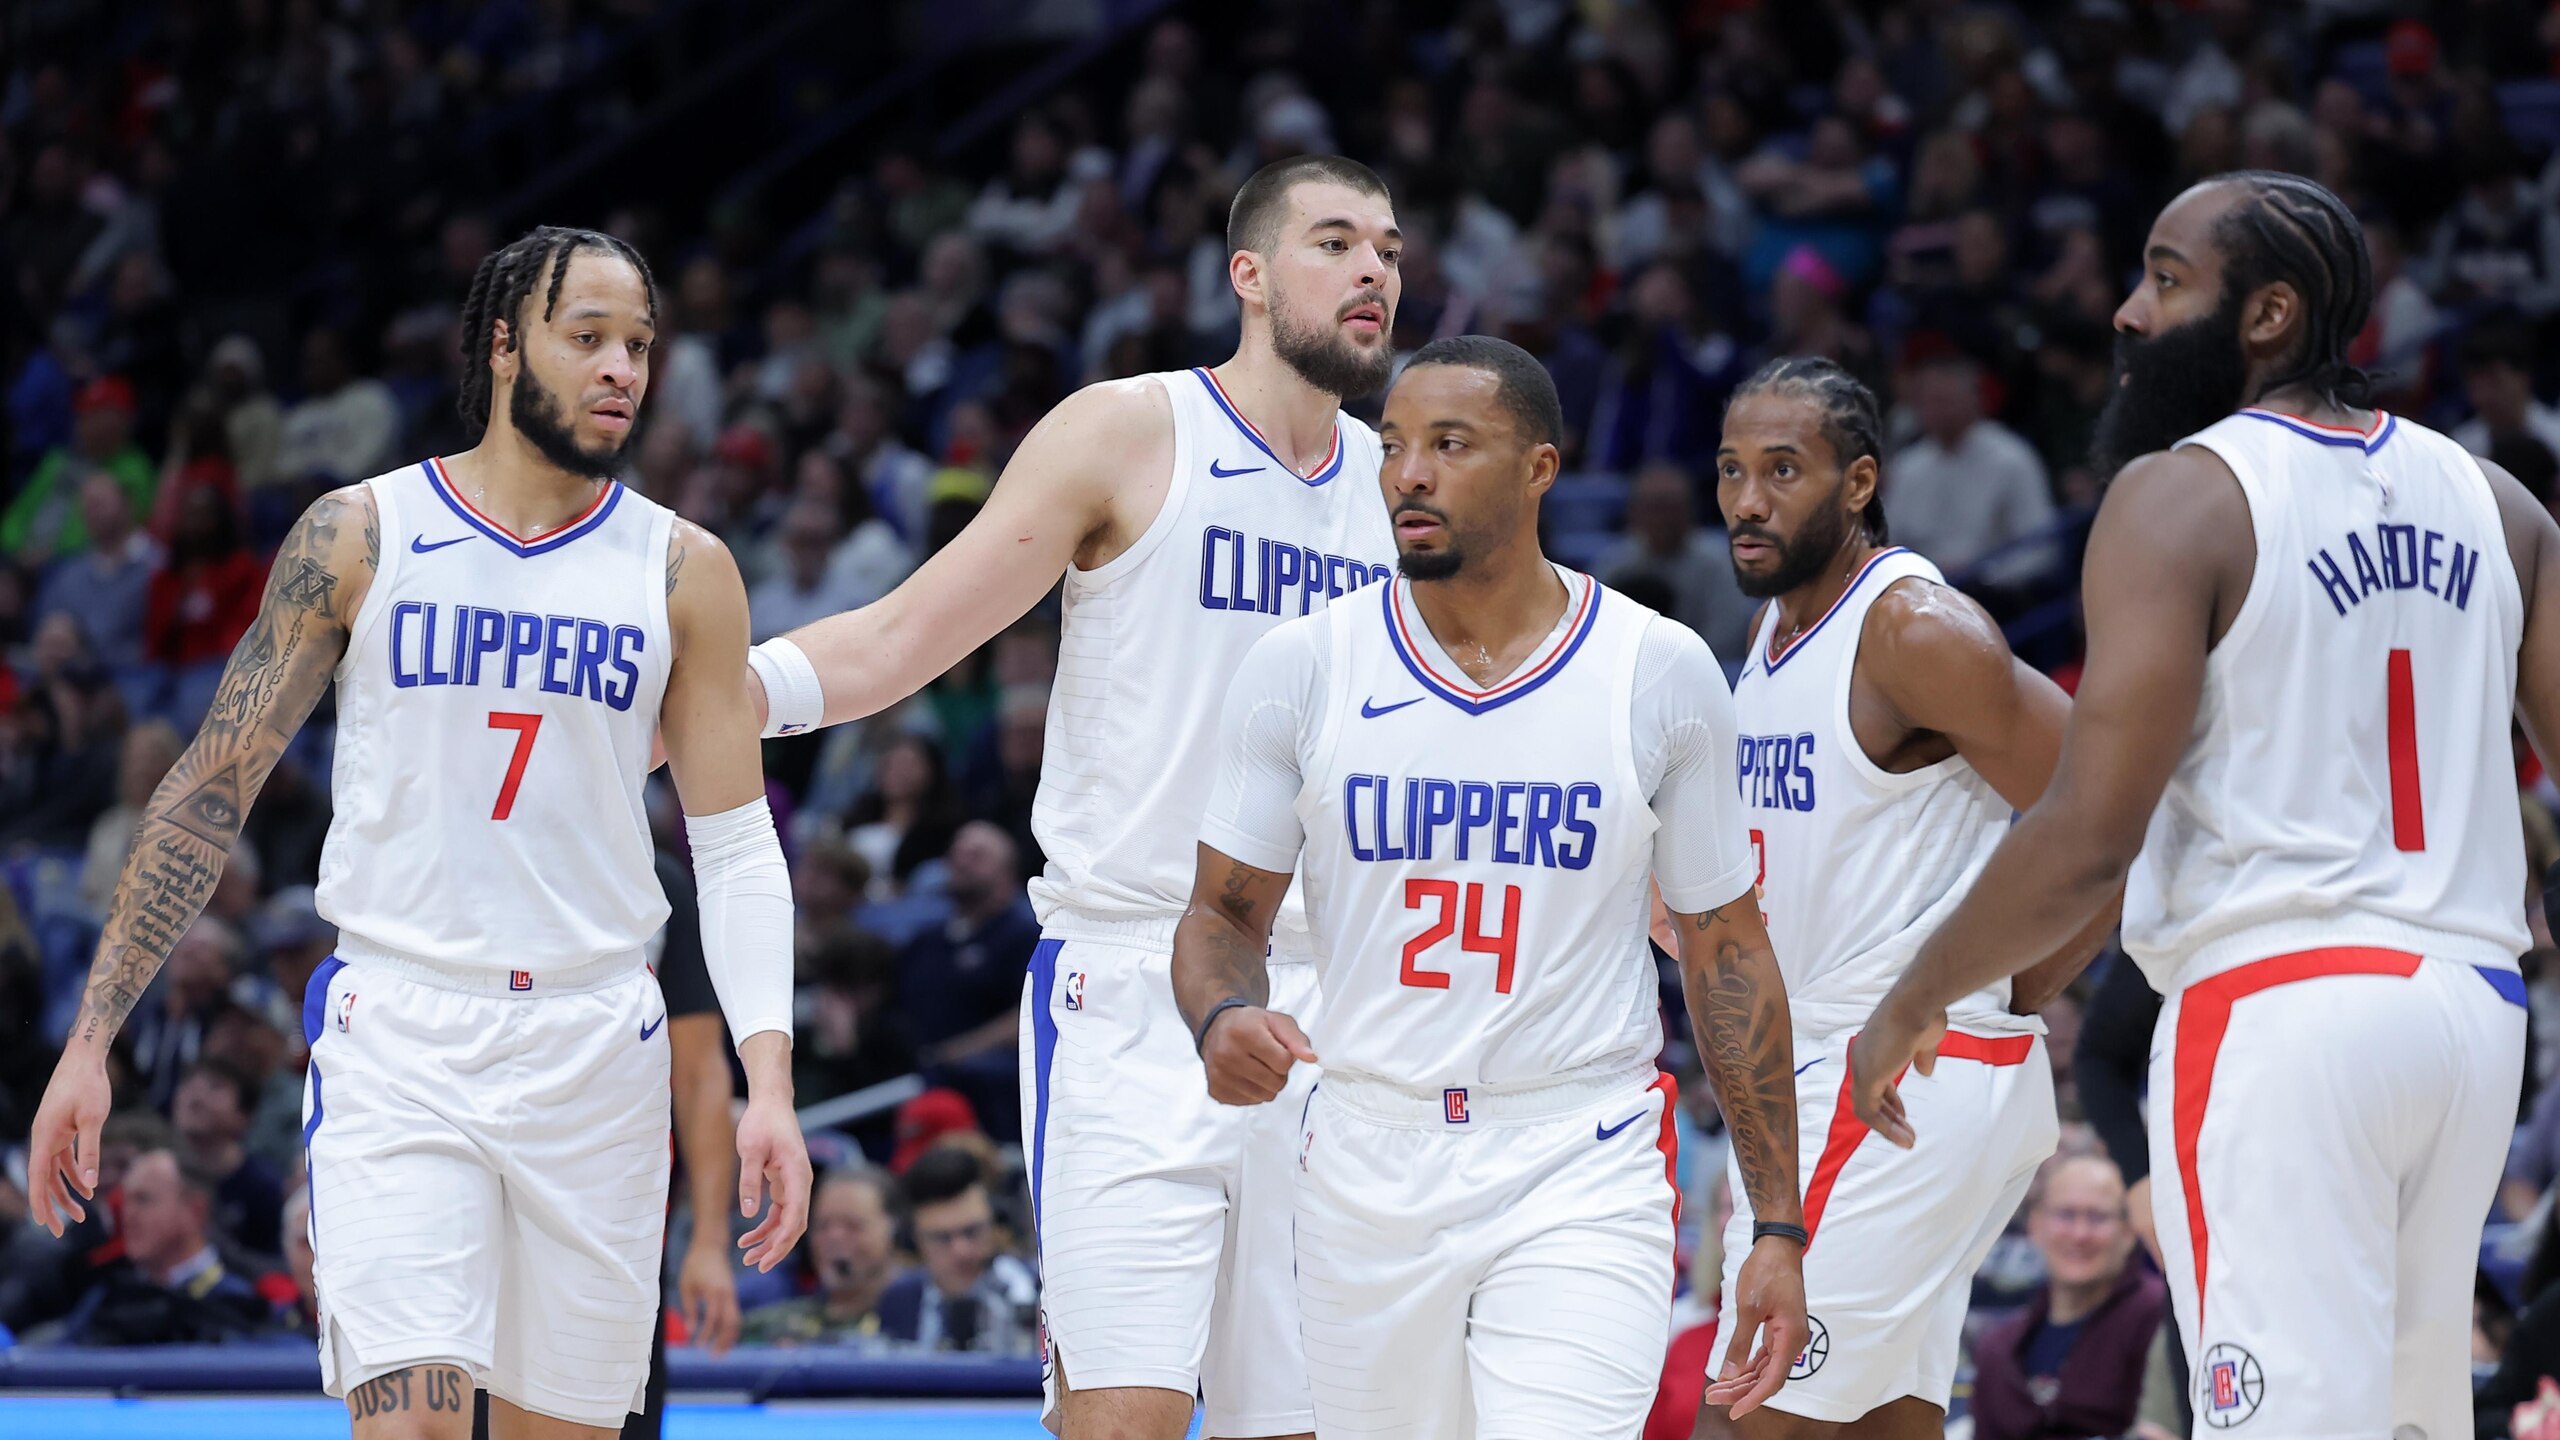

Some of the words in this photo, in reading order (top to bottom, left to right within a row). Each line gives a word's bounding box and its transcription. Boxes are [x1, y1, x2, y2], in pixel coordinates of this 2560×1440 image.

[389, 600, 645, 712] CLIPPERS
[487, 711, 543, 821] 7
[2387, 648, 2426, 852] 1
[1343, 773, 1602, 871] CLIPPERS
[1400, 878, 1521, 994] 24
[354, 1370, 413, 1421] JUST
[426, 1369, 461, 1413] US
